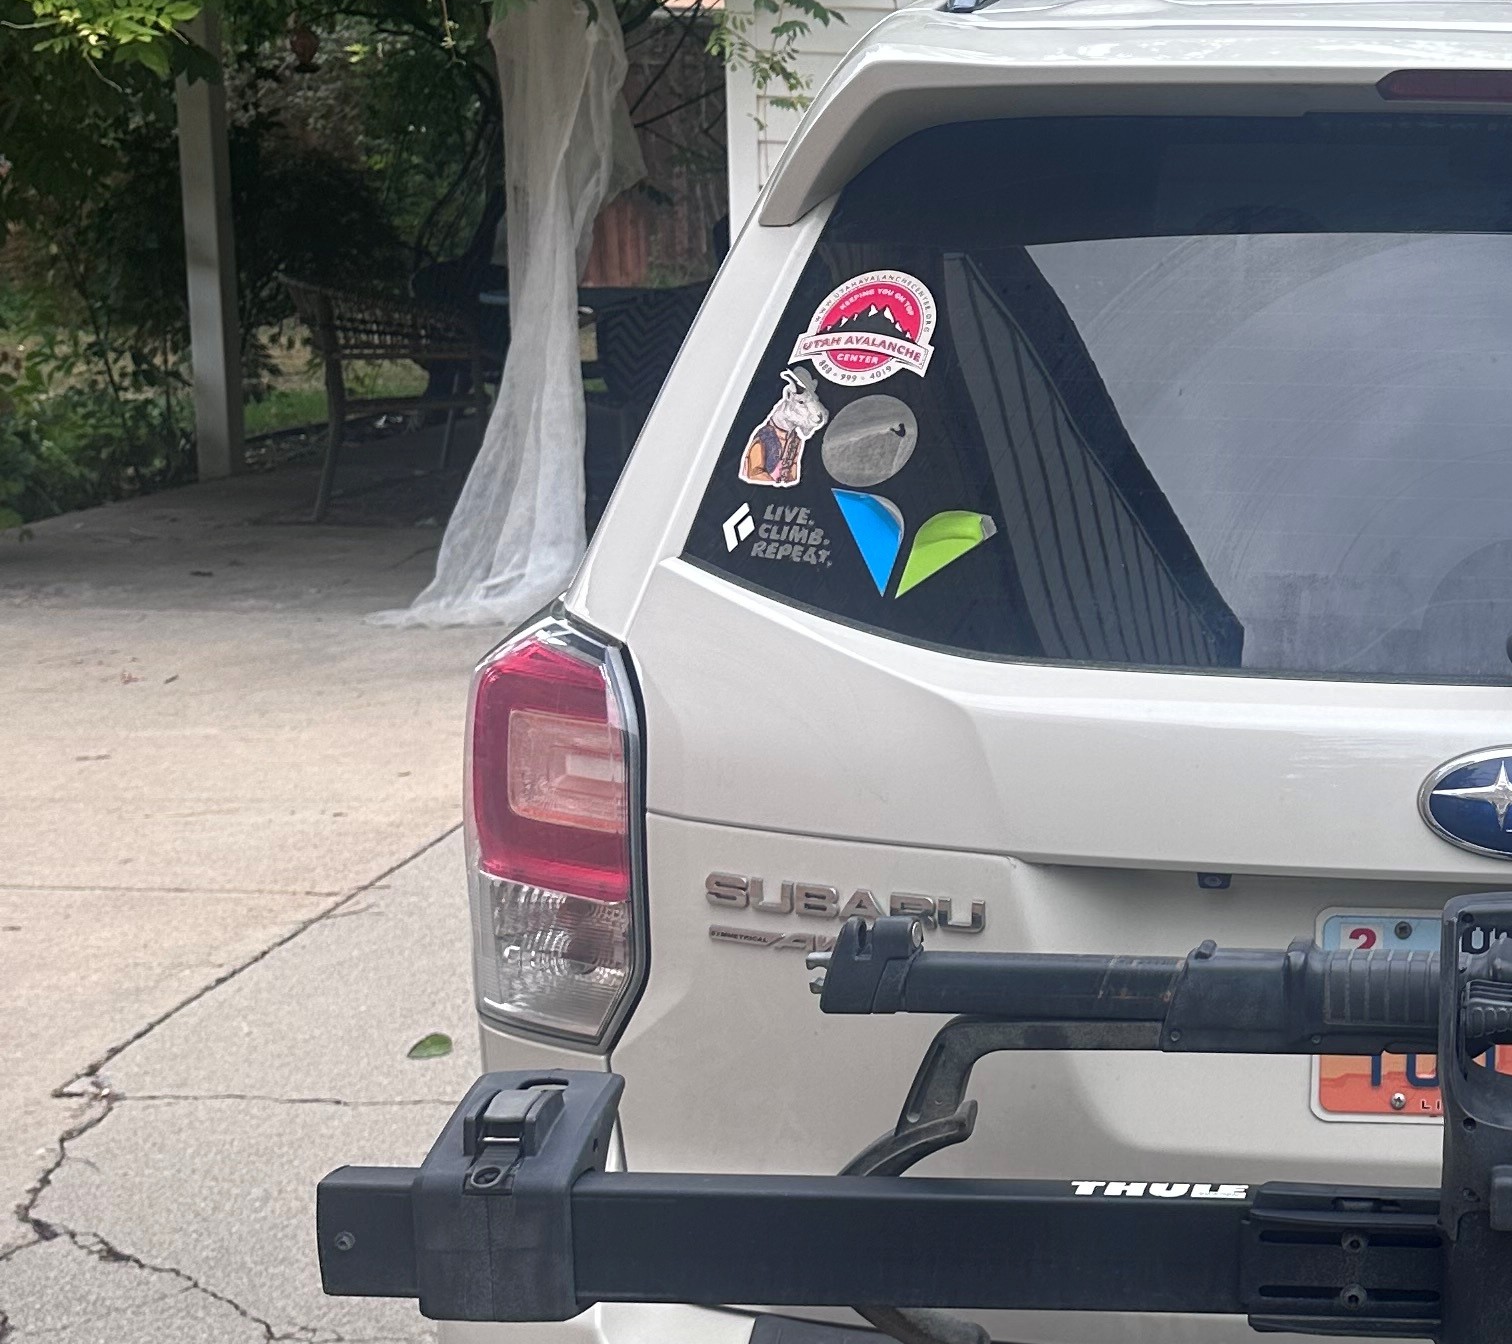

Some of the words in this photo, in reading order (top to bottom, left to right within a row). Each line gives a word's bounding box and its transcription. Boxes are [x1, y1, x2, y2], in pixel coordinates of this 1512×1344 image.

[878, 288, 895, 297] YOU
[894, 292, 906, 303] ON
[904, 301, 915, 316] TOP
[803, 336, 842, 351] UTAH
[844, 335, 922, 363] AVALANCHE
[836, 353, 879, 365] CENTER
[763, 503, 815, 526] LIVE.
[758, 522, 831, 546] CLIMB.
[705, 871, 986, 934] SUBARU
[1071, 1181, 1250, 1199] THULE
